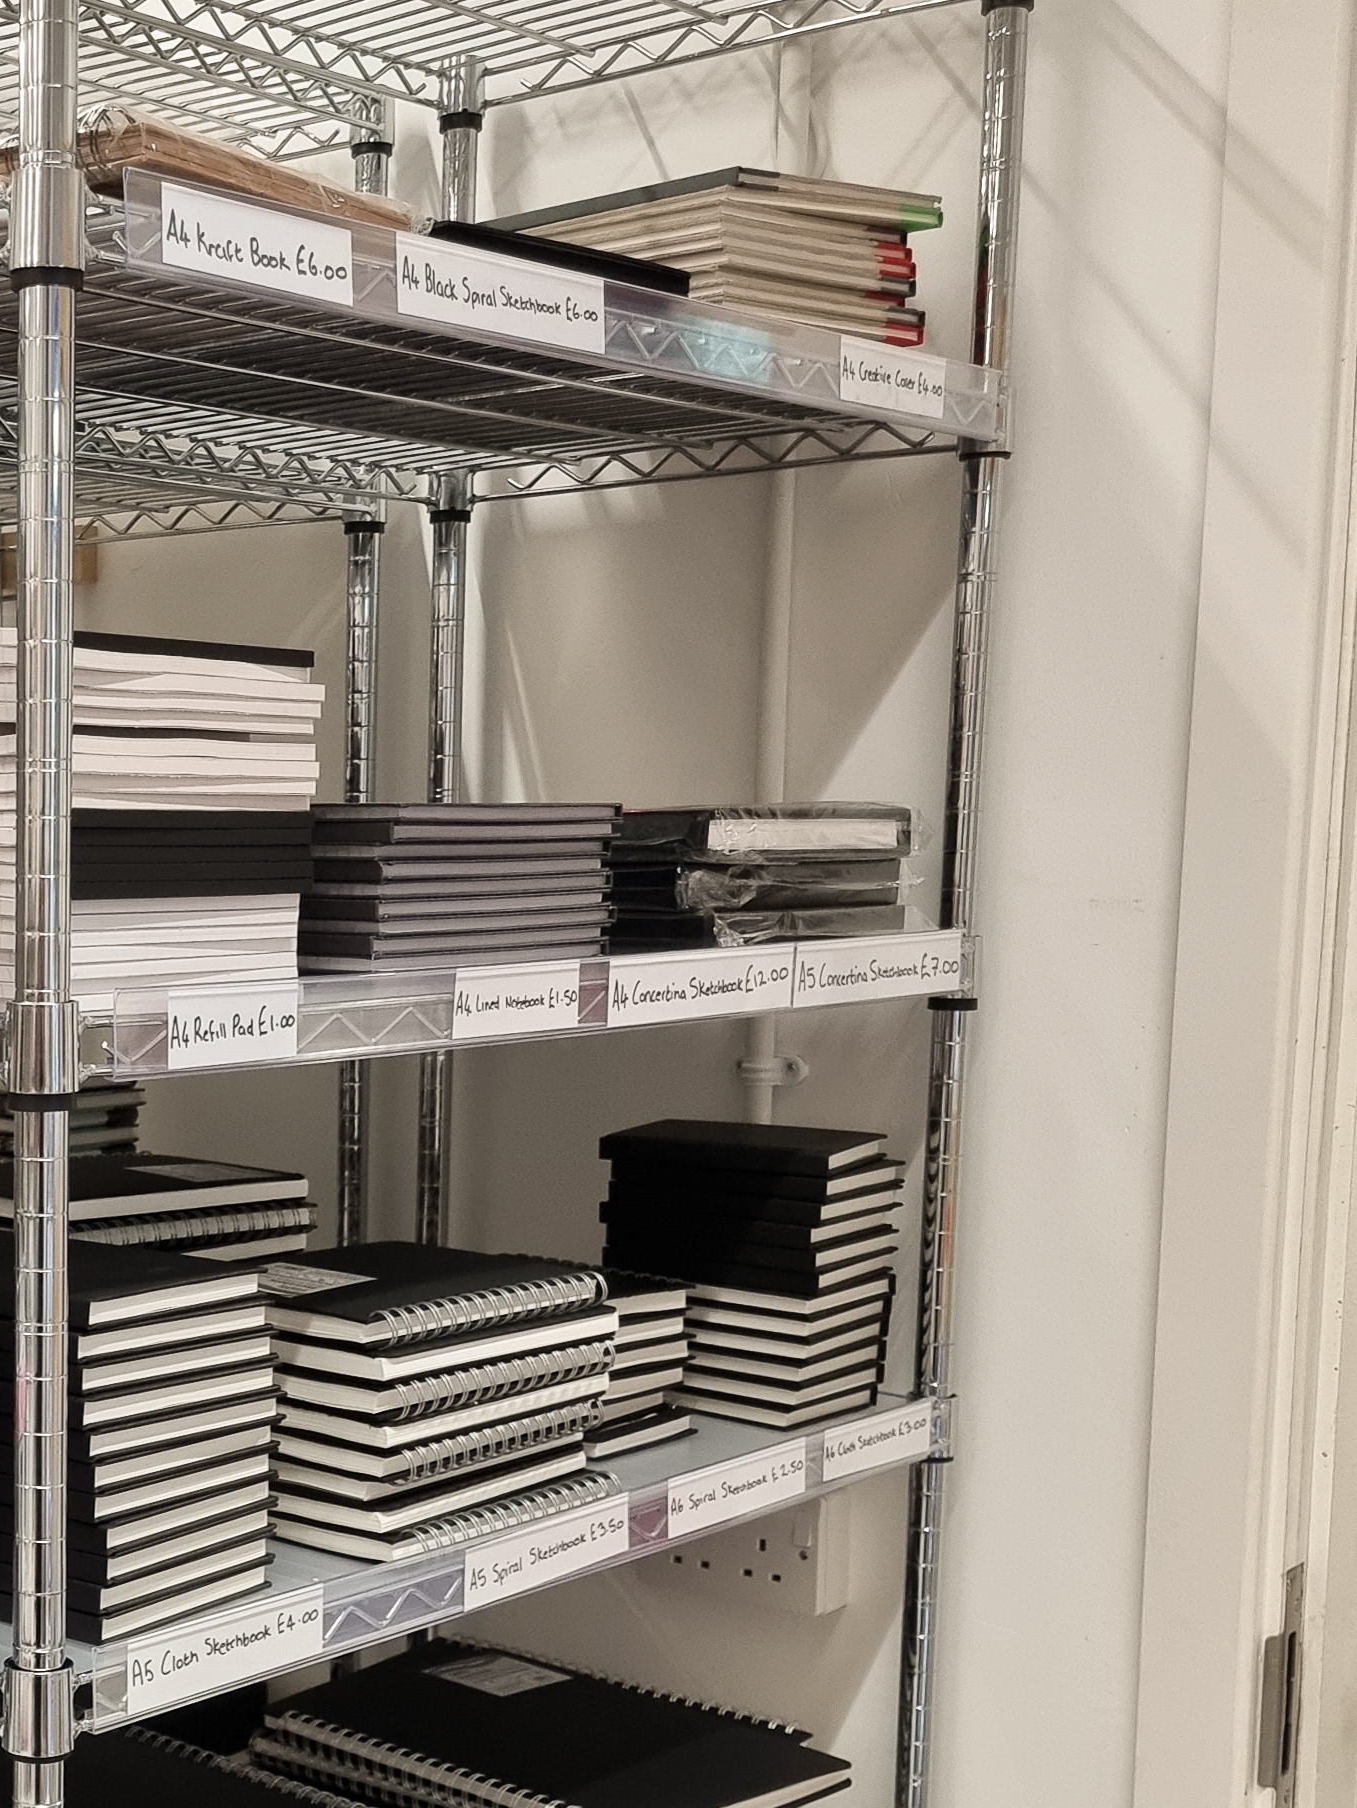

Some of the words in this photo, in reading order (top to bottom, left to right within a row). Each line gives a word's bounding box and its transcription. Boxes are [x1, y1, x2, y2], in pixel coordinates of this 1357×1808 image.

[166, 208, 191, 250] A4
[197, 227, 244, 264] Kraft
[250, 236, 291, 273] Book
[296, 245, 348, 282] £6.00
[402, 255, 420, 290] A4
[424, 263, 459, 302] Black
[462, 276, 498, 310] Spiral
[500, 285, 562, 318] Sketchbook
[565, 297, 599, 323] £6.00
[843, 356, 856, 381] A4
[858, 361, 891, 386] Creative
[917, 371, 943, 397] £4.00
[611, 984, 629, 1010] A4
[631, 983, 687, 1006] Concertina
[690, 975, 744, 999] Sketchbook
[745, 964, 789, 993] £12.00
[799, 964, 816, 990] A5
[818, 961, 868, 988] Concertina
[869, 958, 919, 982] Sketchbook
[920, 953, 959, 980] £7.00
[456, 990, 473, 1015] A4
[475, 991, 501, 1012] Lined
[505, 989, 545, 1010] Notebook
[548, 988, 578, 1009] £1.50
[170, 1016, 190, 1050] A4
[193, 1012, 227, 1041] Refill
[232, 1011, 254, 1037] Pad
[257, 1005, 295, 1037] £1.00
[824, 1445, 837, 1463] A6
[857, 1428, 897, 1452] Sketchbook
[897, 1417, 928, 1438] £3.00
[670, 1498, 685, 1516] A6
[688, 1487, 718, 1512] Spiral
[721, 1472, 769, 1499] Sketchbook
[469, 1566, 487, 1592] A5
[492, 1551, 524, 1584] Spiral
[529, 1530, 588, 1566] Sketchbook
[589, 1517, 625, 1541] £3.50
[131, 1658, 155, 1688] A5
[161, 1648, 200, 1677] Cloth
[204, 1628, 272, 1657] Sketchbook
[276, 1607, 319, 1636] £4.00
